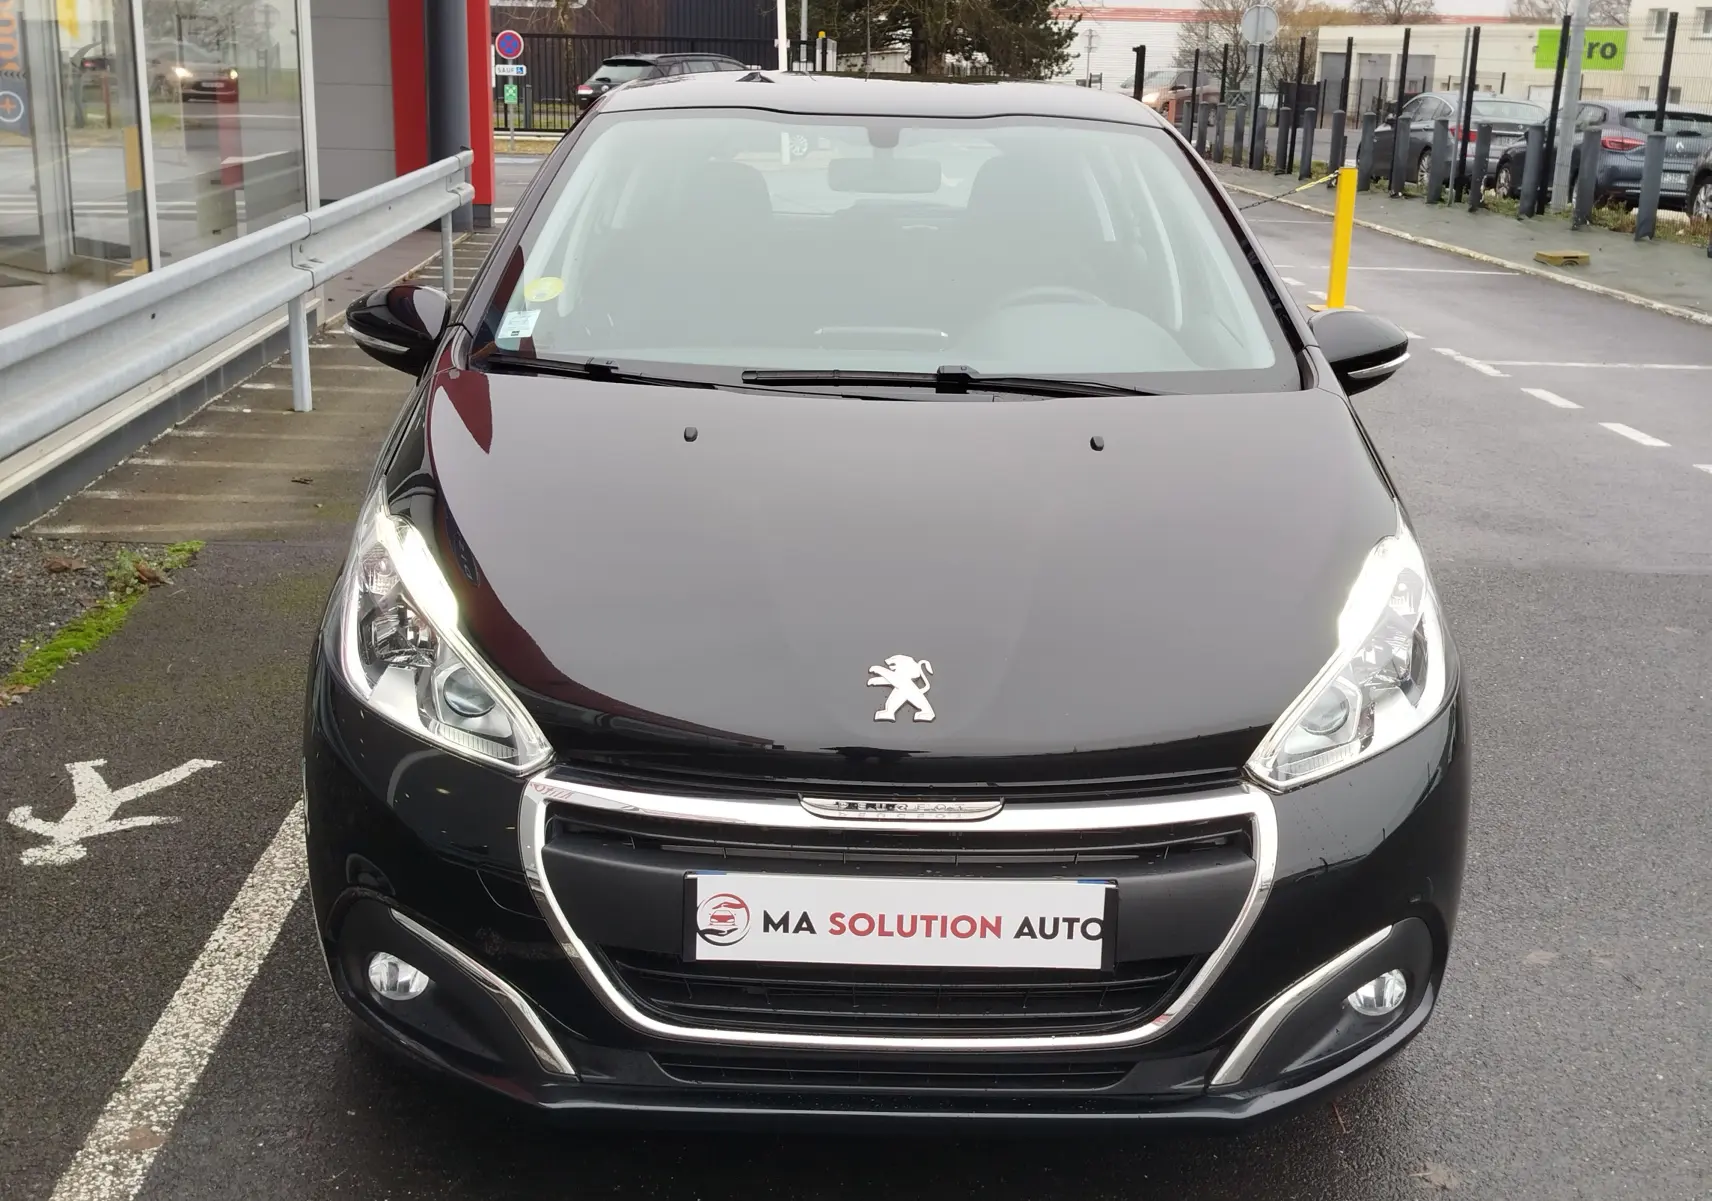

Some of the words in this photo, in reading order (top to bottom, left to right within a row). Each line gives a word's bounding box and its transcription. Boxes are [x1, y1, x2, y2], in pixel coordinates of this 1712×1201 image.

[762, 909, 817, 935] MA
[828, 911, 1003, 939] SOLUTION
[1013, 915, 1105, 941] AUTO
